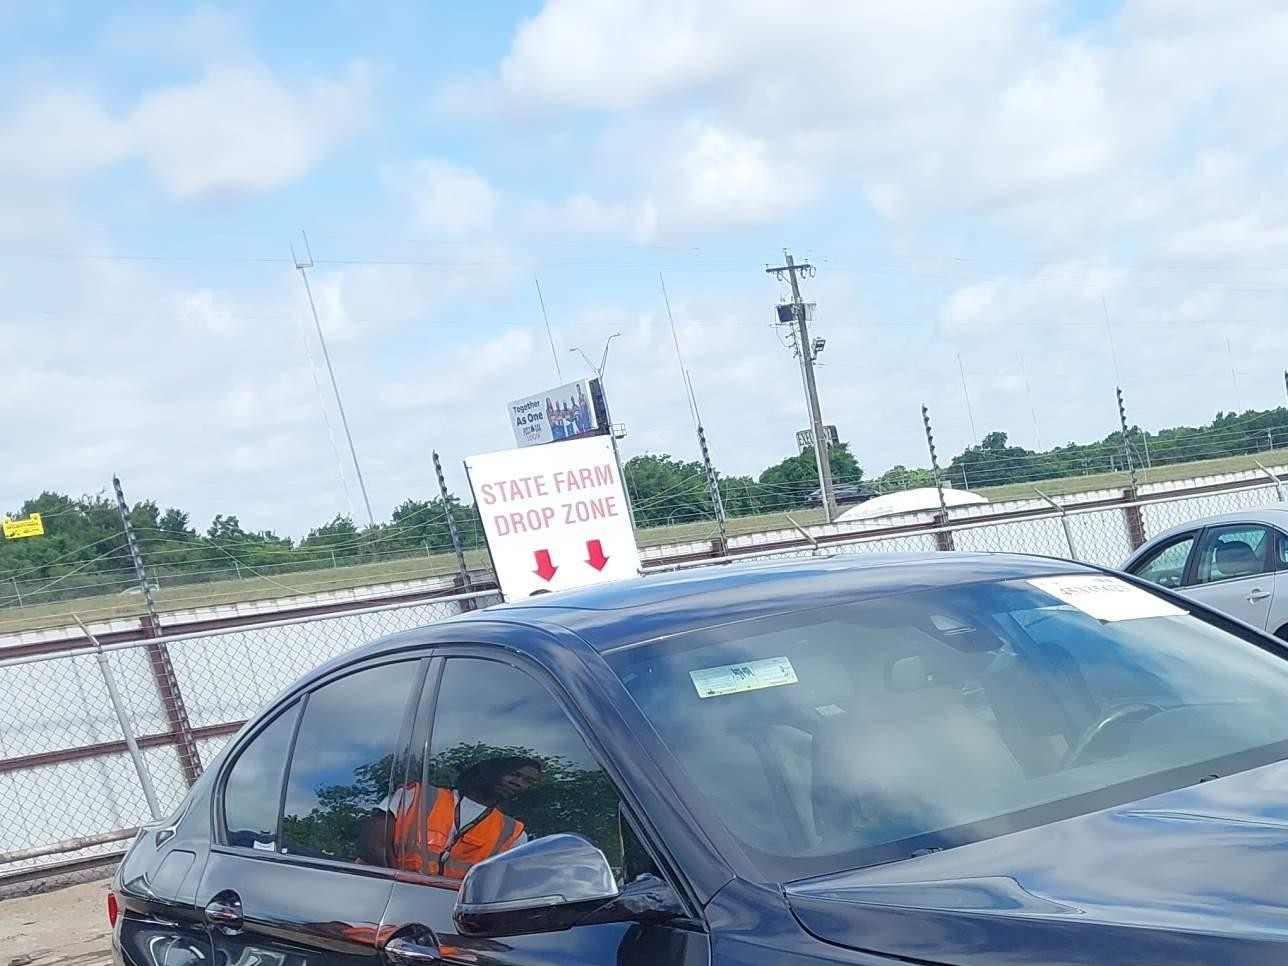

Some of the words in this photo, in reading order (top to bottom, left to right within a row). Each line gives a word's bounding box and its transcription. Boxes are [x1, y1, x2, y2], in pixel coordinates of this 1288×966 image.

[512, 400, 540, 414] Together
[516, 416, 527, 427] As
[528, 412, 544, 424] One
[480, 475, 549, 506] STATE
[553, 464, 615, 494] FARM
[494, 506, 556, 537] DROP
[561, 496, 620, 526] ZONE
